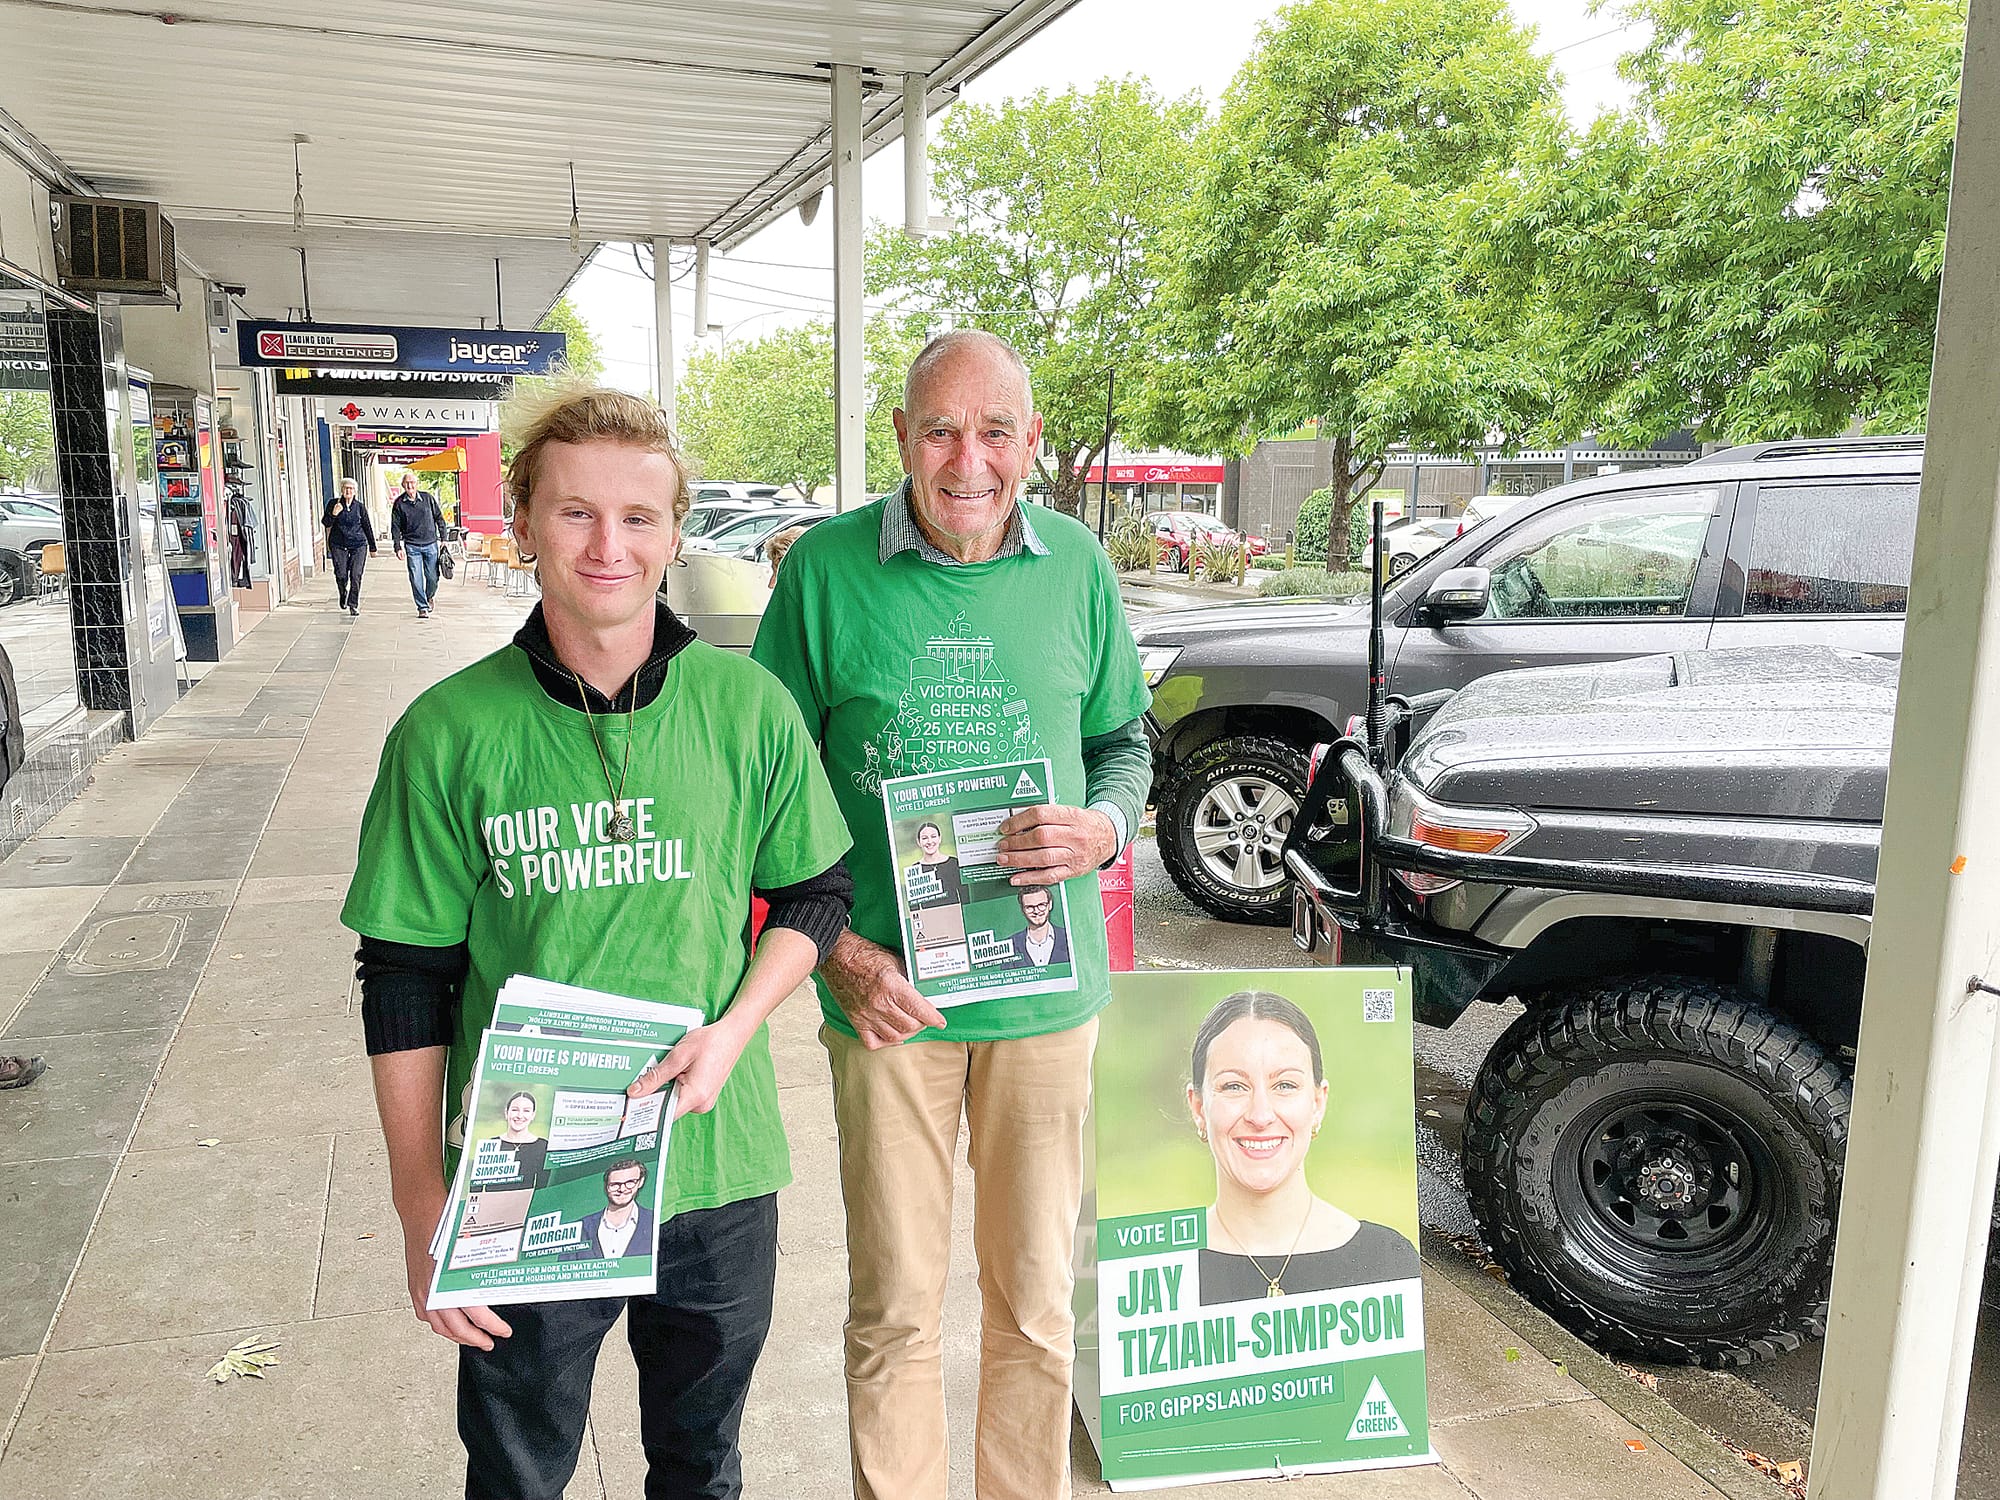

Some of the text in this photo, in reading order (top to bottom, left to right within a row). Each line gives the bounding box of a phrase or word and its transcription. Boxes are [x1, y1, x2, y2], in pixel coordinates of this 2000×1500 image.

[285, 335, 334, 345] LEADING EDGE
[287, 347, 392, 358] ELECTRONICS
[448, 337, 526, 364] jaycar
[372, 407, 475, 421] WAKACHI
[919, 685, 1002, 699] VICTORIAN
[930, 703, 992, 717] GREENS
[923, 722, 997, 736] 25 YEARS
[926, 740, 991, 754] STRONG
[1206, 763, 1290, 784] All-Terrain
[893, 774, 1008, 803] YOUR VOTE IS POWERFUL
[1019, 778, 1030, 787] THE
[1015, 786, 1037, 795] GREENS
[895, 804, 913, 813] VOTE
[924, 798, 950, 807] GREENS
[480, 806, 560, 857] YOUR
[520, 838, 695, 897] POWERFUL.
[907, 867, 920, 878] JAY
[909, 883, 940, 898] SIMPSON
[972, 934, 990, 947] MAT
[973, 943, 1010, 960] MORGAN
[493, 1043, 632, 1071] YOUR VOTE IS POWERFUL
[490, 1062, 513, 1072] VOTE
[527, 1065, 560, 1076] GREENS
[480, 1142, 498, 1153] JAY
[478, 1154, 511, 1165] TIZIANI-
[475, 1165, 516, 1177] SIMPSON
[530, 1215, 557, 1231] MAT
[527, 1226, 577, 1247] MORGAN
[1117, 1223, 1166, 1248] VOTE
[525, 1250, 537, 1258] FOR
[470, 1271, 488, 1280] VOTE
[499, 1268, 525, 1277] GREENS
[526, 1267, 540, 1275] FOR
[541, 1265, 560, 1274] MORE
[561, 1263, 591, 1272] CLIMATE
[592, 1261, 620, 1269] ACTION,
[480, 1277, 525, 1287] AFFORDABLE
[525, 1274, 555, 1283] HOUSING
[572, 1269, 608, 1279] INTEGRITY
[1117, 1264, 1183, 1318] JAY
[1117, 1293, 1405, 1378] TIZIANI-SIMPSON
[1119, 1375, 1334, 1425] FOR GIPPSLAND SOUTH
[1366, 1400, 1388, 1416] THE
[1356, 1416, 1398, 1434] GREENS
